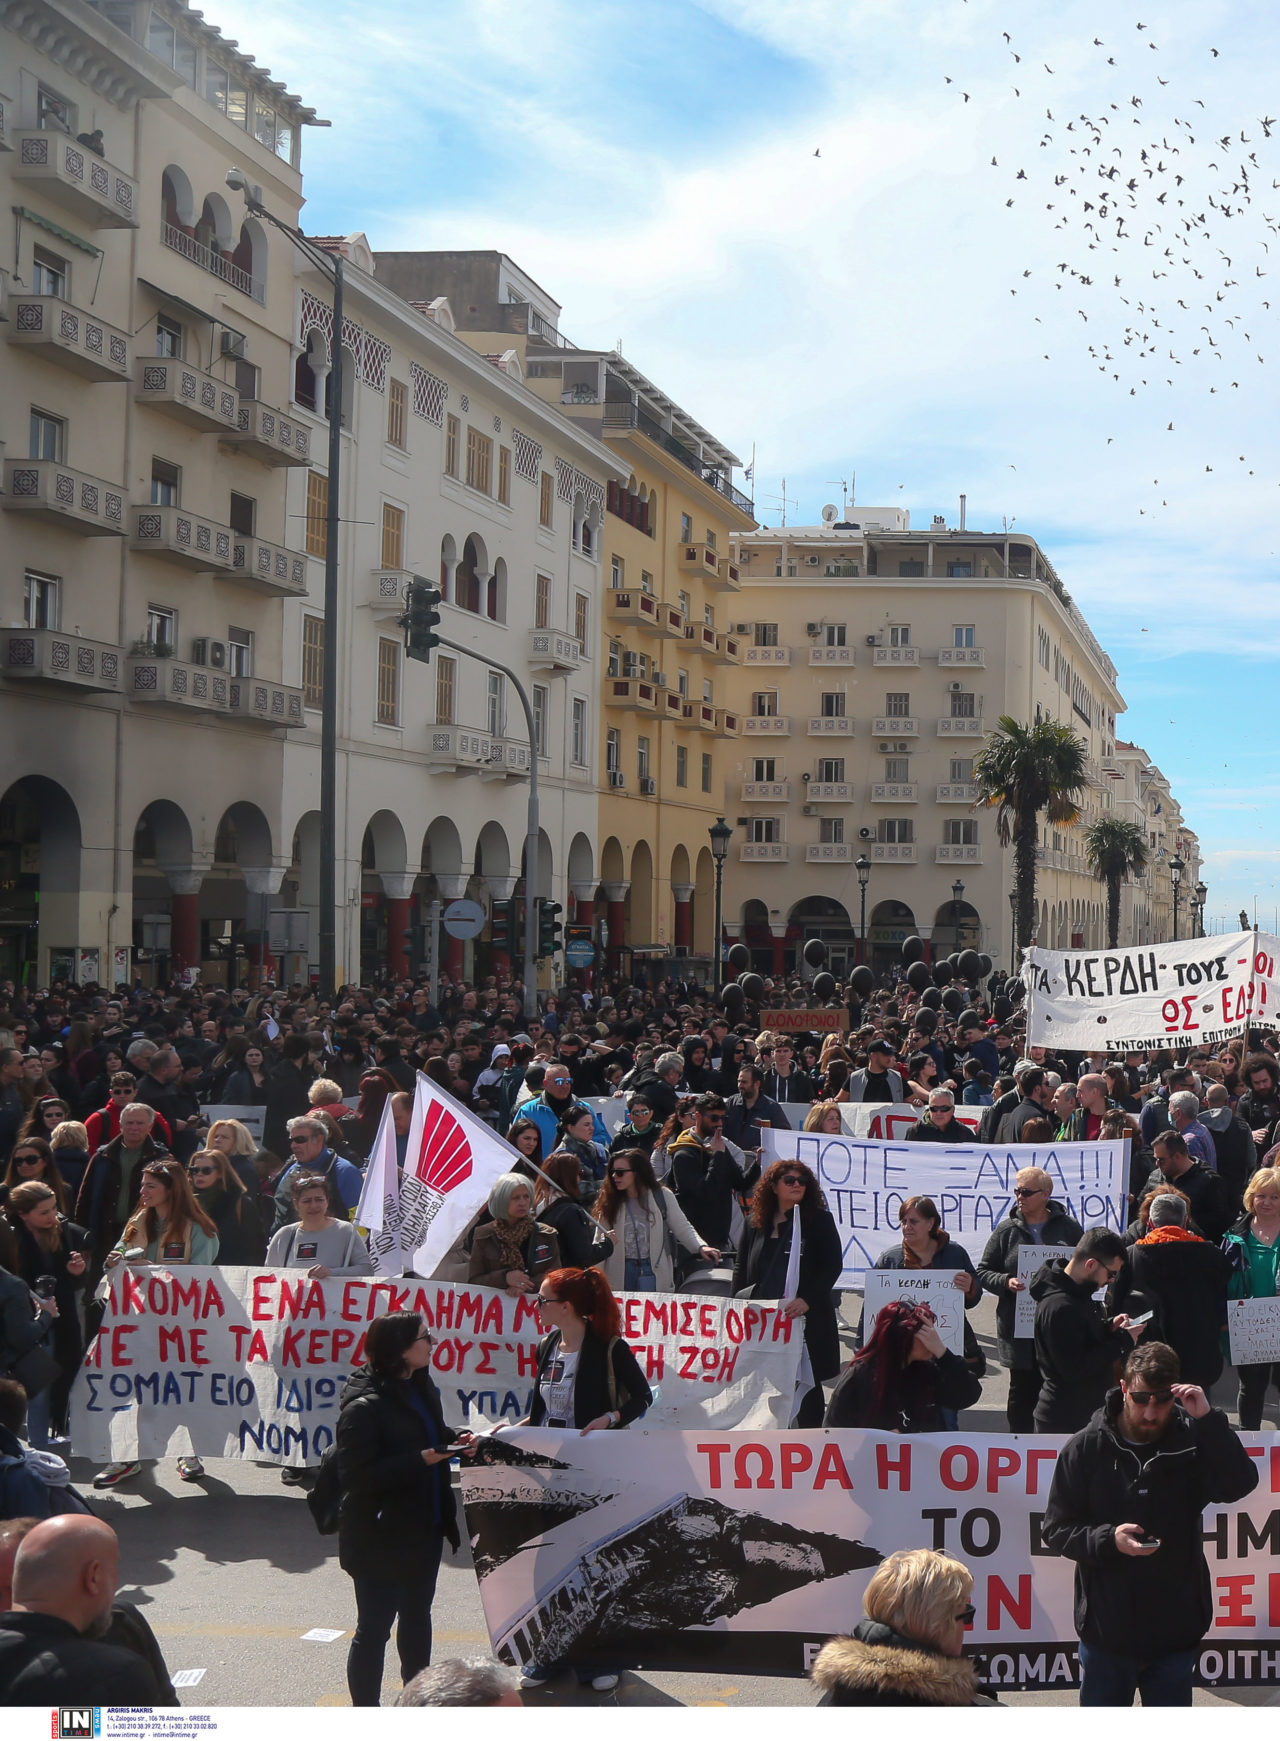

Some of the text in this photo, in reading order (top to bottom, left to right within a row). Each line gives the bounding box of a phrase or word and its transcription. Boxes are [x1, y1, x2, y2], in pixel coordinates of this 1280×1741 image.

[1030, 963, 1051, 994] ΤΑ
[1064, 952, 1159, 997] ΚΕΡΔΗ
[1173, 957, 1229, 986] ΤΟΥΣ
[1254, 951, 1274, 978] ΟΙ
[1161, 995, 1200, 1032] ΩΣ
[1105, 1035, 1193, 1050] ΣΥΝΤΟΝΙΣΤΙΚΗ
[797, 1136, 909, 1189] ΠΟΤΕ
[1022, 1251, 1037, 1259] ΤΑ
[1042, 1251, 1066, 1259] ΚΕΡΔΗ
[898, 1278, 931, 1289] ΚΕΡΔΗ
[252, 1273, 326, 1322] ΕΝΑ
[341, 1281, 504, 1336] ΕΓΚΛΗΜΑ
[616, 1297, 718, 1338] ΕΜΙΣΕ
[726, 1308, 794, 1344] ΟΡΓΗ
[158, 1324, 211, 1366] ΜΕ
[228, 1324, 269, 1364] ΤΑ
[432, 1338, 500, 1375] ΟΥΣ
[679, 1346, 740, 1383] ΖΩΗ
[86, 1371, 256, 1413] ΣΩΜΑΤΕΙΟ
[697, 1443, 854, 1491] ΤΩΡΑ
[875, 1443, 912, 1492] Η
[939, 1444, 1059, 1495] ΟΡΓ
[921, 1507, 1001, 1557] ΤΟ
